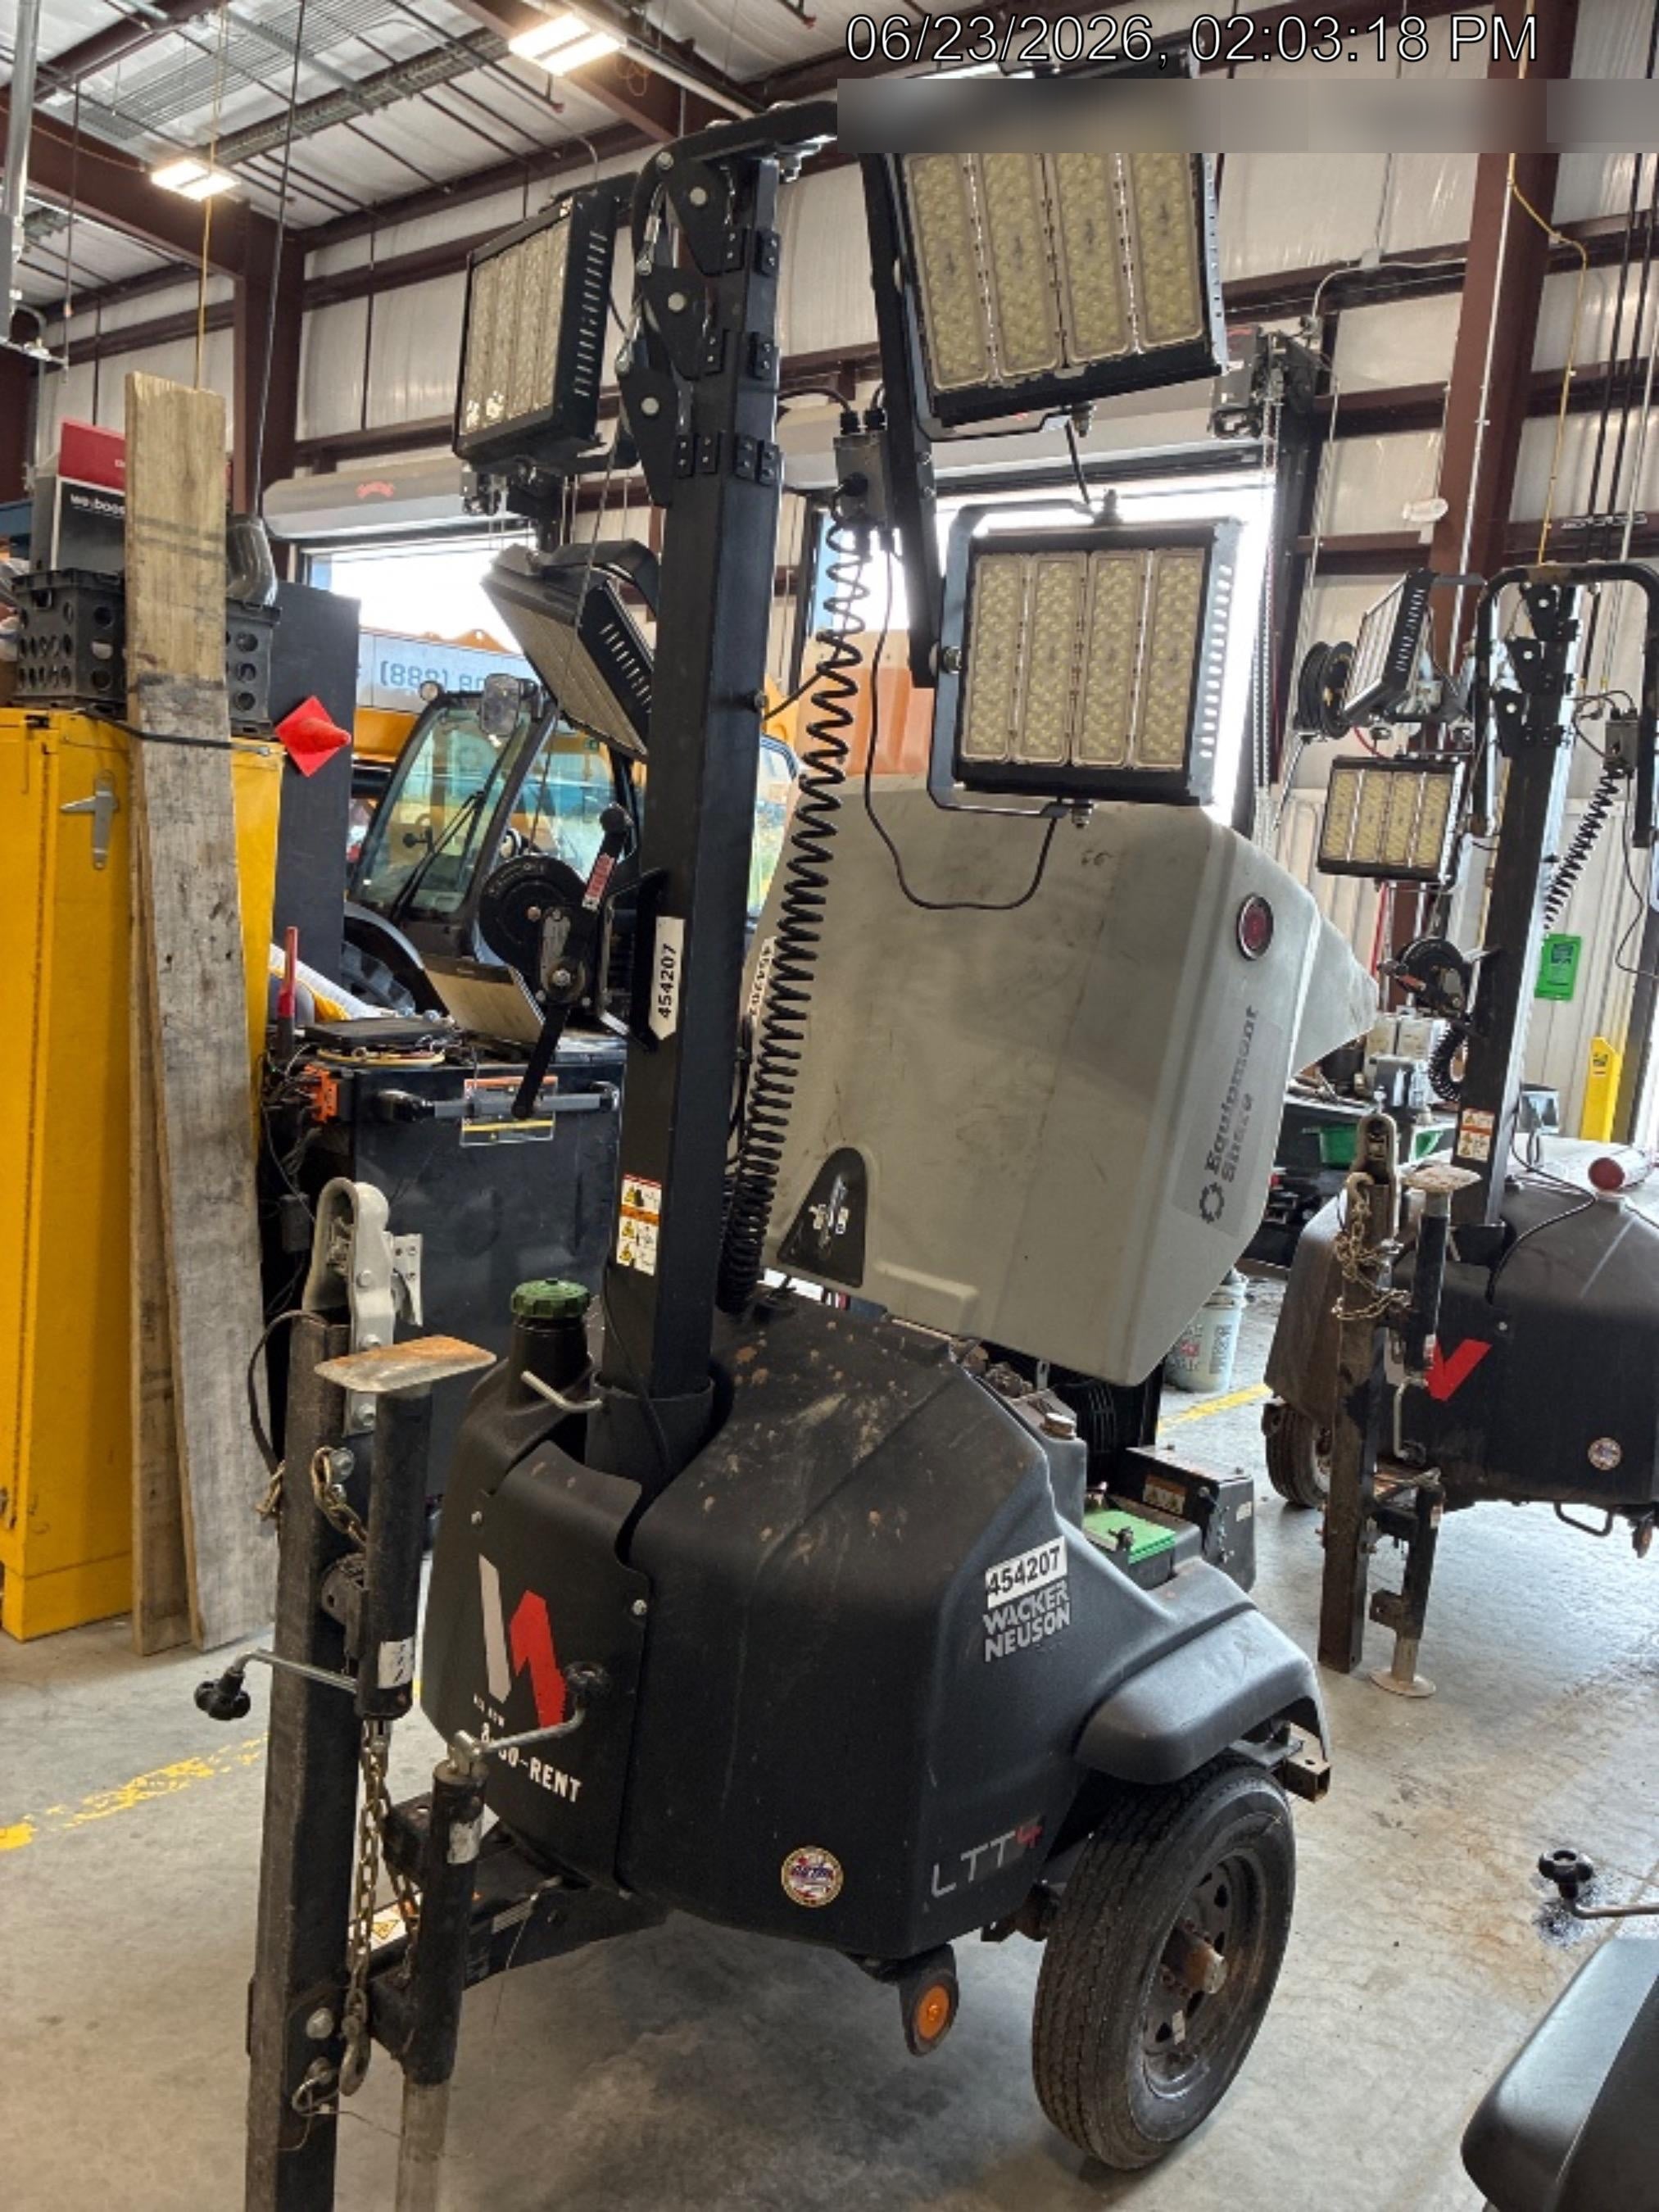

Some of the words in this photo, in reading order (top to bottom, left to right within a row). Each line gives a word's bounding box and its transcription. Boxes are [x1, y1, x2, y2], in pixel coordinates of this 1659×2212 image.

[658, 943, 677, 1019] 454207
[989, 1544, 1060, 1595] 454207
[982, 1579, 1069, 1635] WACKER
[985, 1602, 1070, 1662] NEUSON
[931, 1826, 1042, 1898] LTT4
